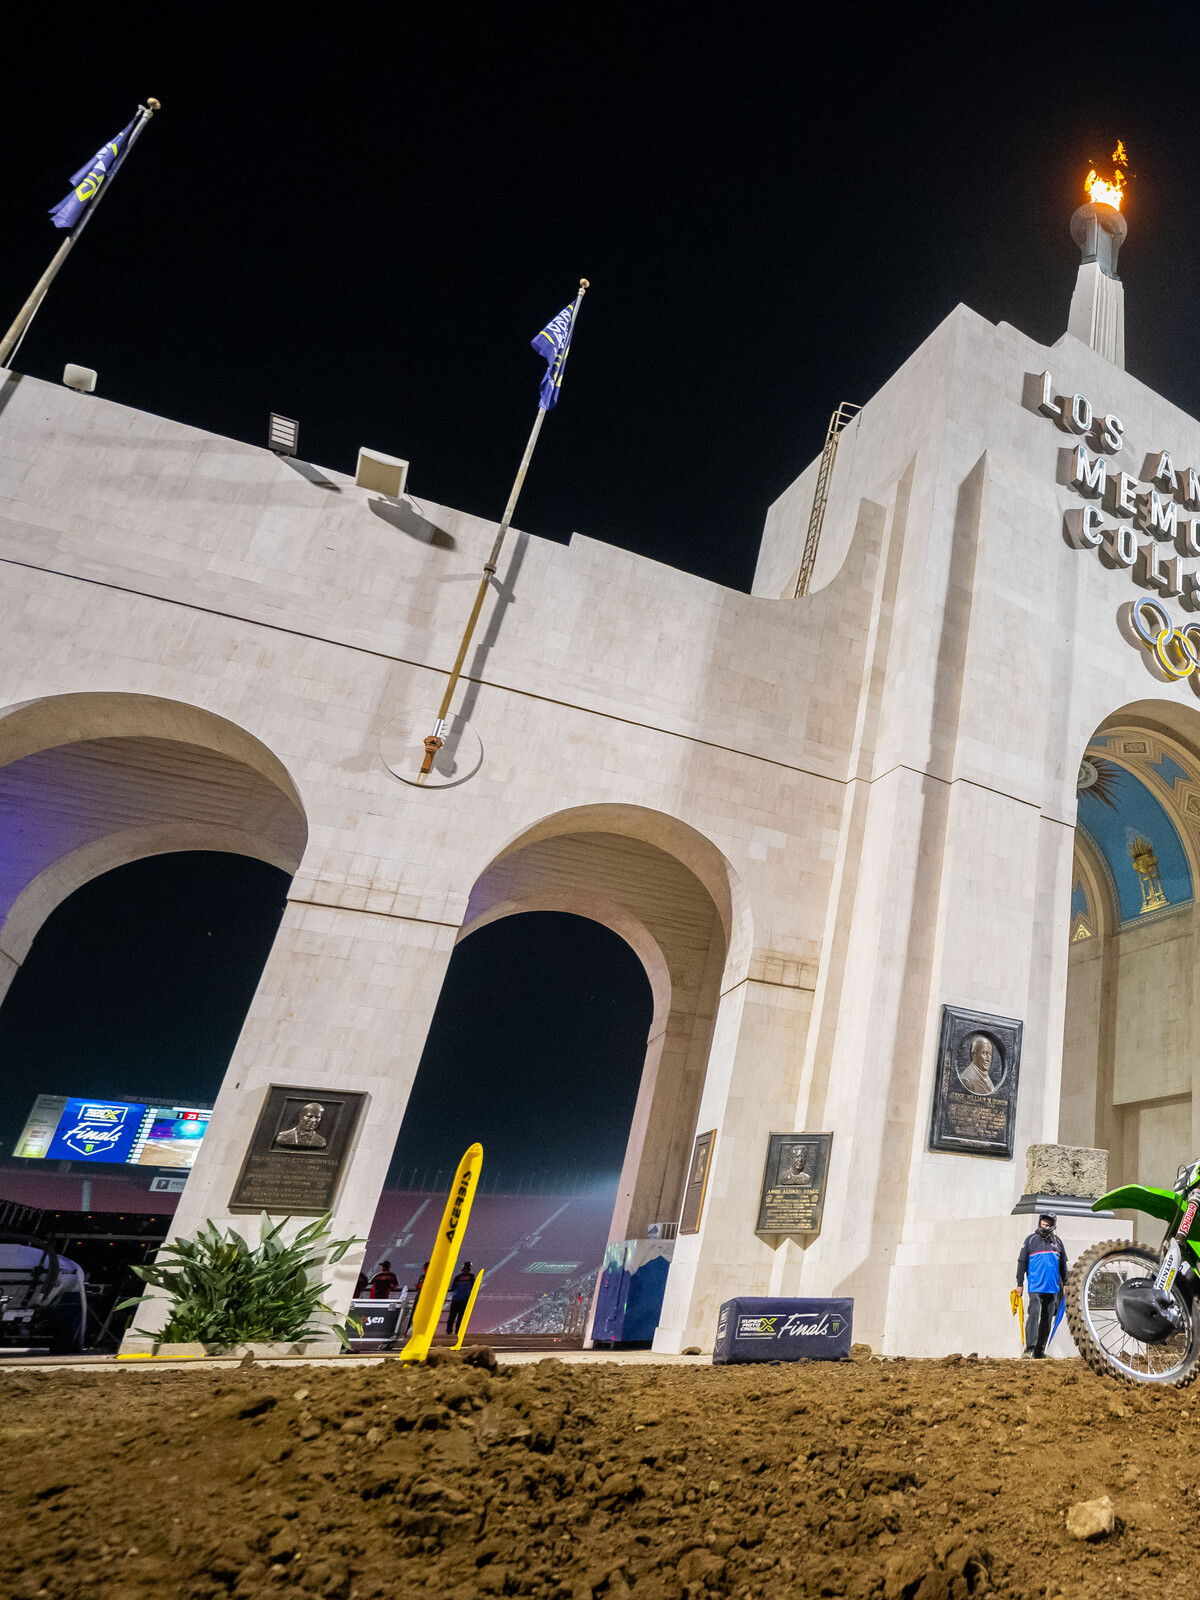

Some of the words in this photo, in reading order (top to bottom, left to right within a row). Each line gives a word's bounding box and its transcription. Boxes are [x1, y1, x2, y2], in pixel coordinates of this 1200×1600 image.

[1038, 370, 1124, 455] LOS
[62, 1121, 124, 1142] Finals
[1181, 1203, 1197, 1233] SHOWA
[1158, 1254, 1174, 1291] DUNLOP
[777, 1313, 829, 1339] Finals
